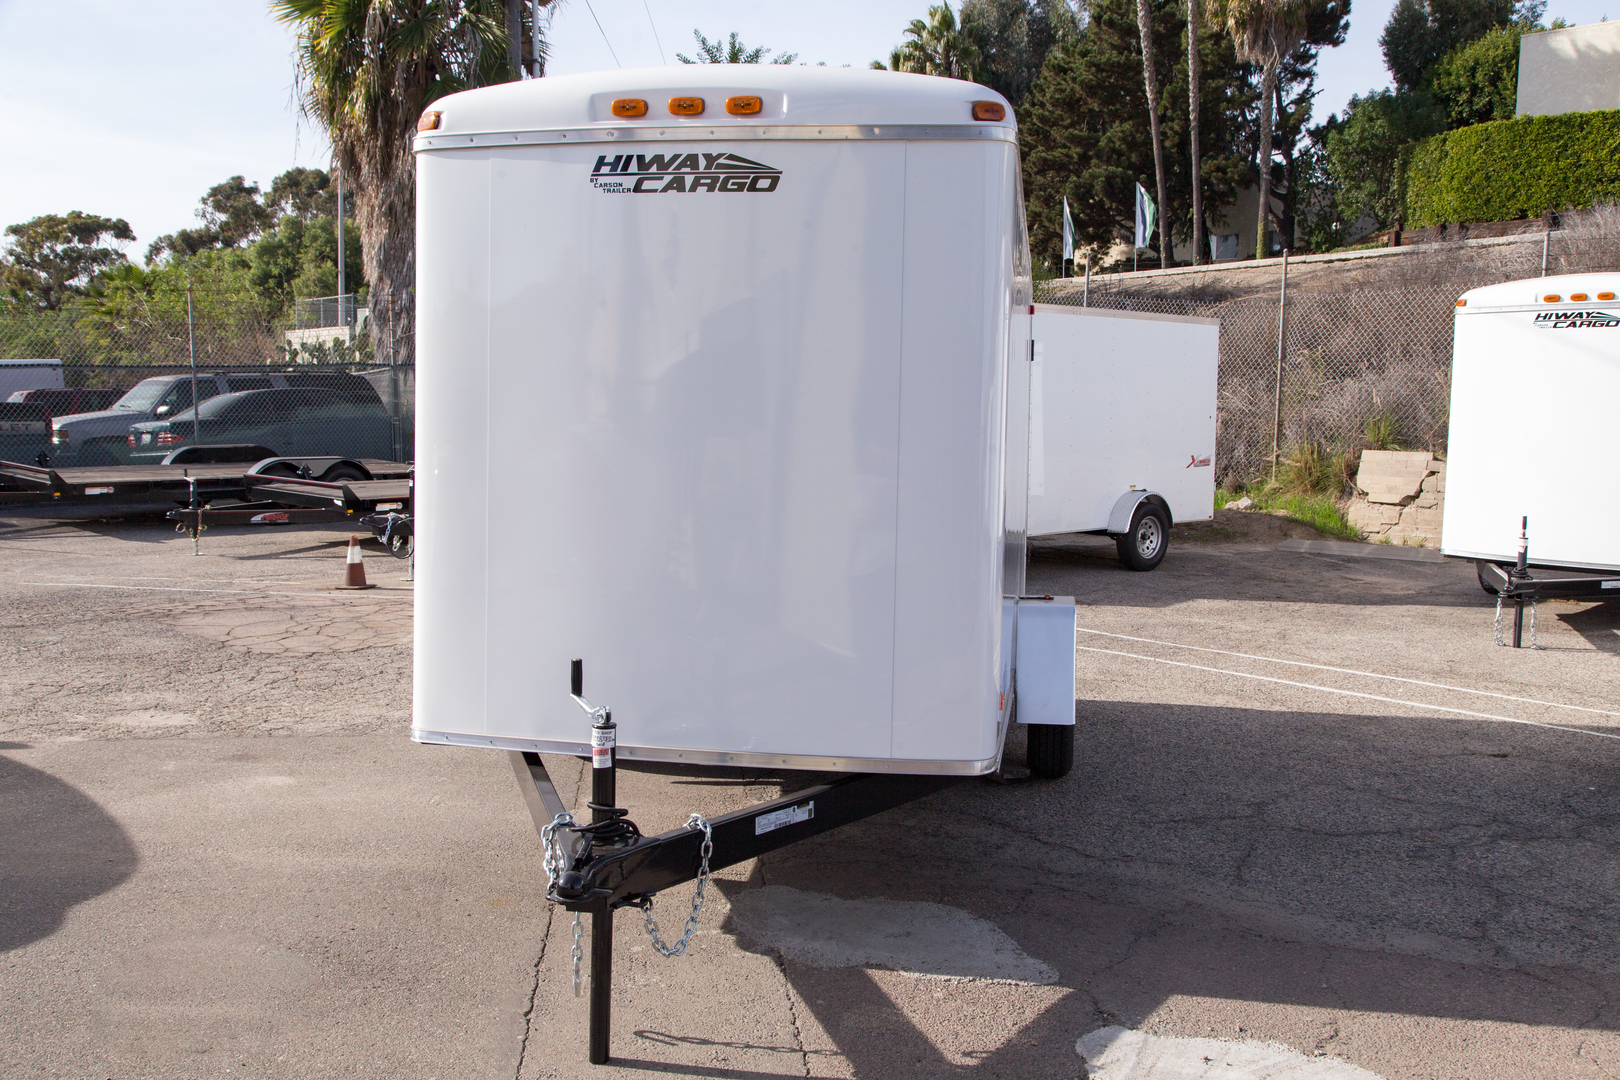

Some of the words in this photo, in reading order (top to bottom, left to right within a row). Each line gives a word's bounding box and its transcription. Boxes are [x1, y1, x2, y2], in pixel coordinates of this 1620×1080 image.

[592, 153, 728, 173] HIWAY
[632, 175, 781, 193] CARGO
[1535, 311, 1596, 321] HIWAY
[1552, 320, 1620, 329] CARGO
[262, 513, 290, 521] MIRAGE
